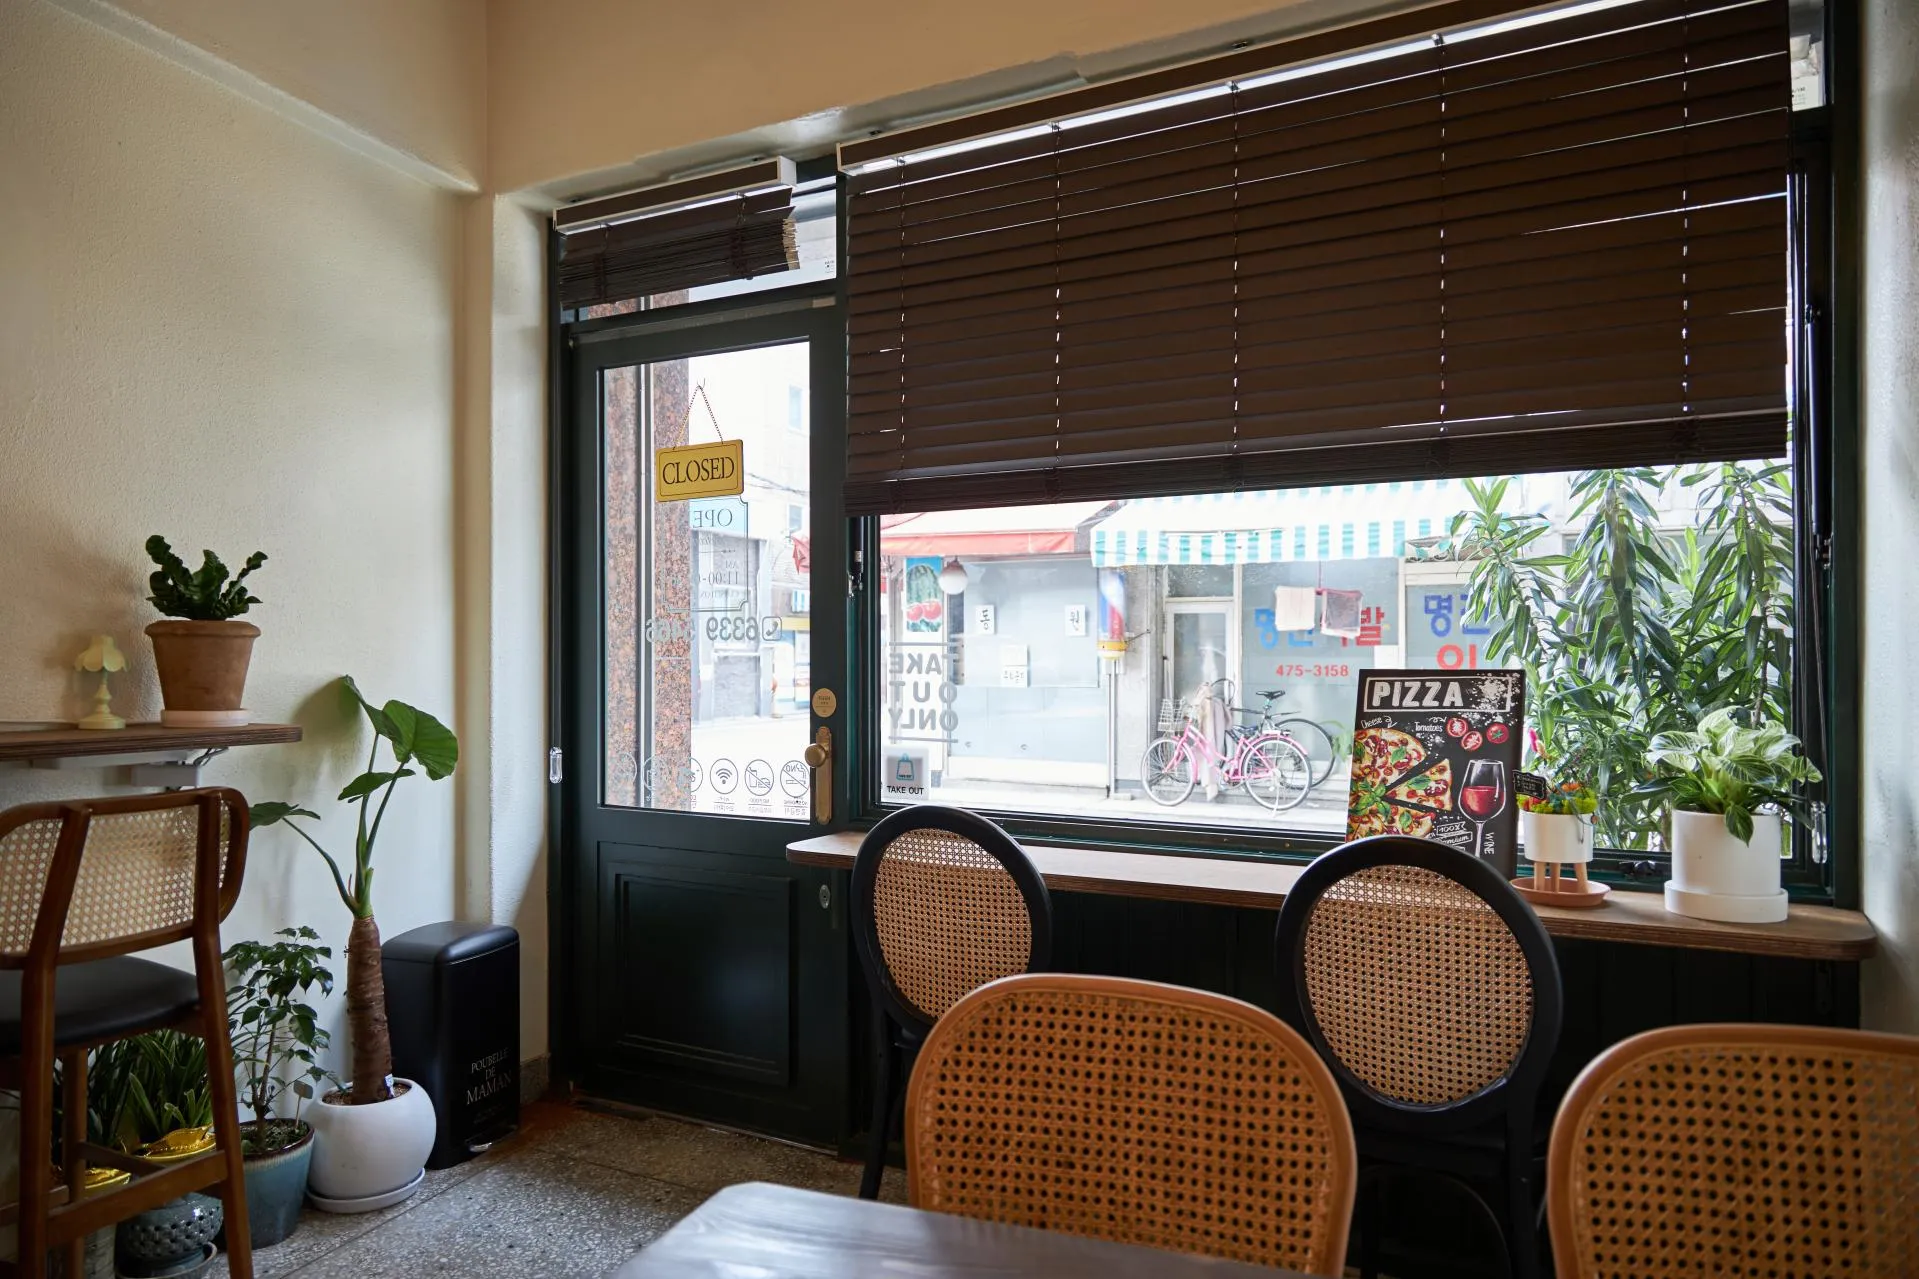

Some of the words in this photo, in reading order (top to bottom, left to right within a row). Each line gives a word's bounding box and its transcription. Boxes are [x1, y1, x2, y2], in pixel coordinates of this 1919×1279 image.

[662, 456, 735, 485] CLOSED
[1275, 664, 1349, 677] 475-3158
[1372, 681, 1464, 707] PIZZA
[1414, 721, 1444, 732] Tomatoes
[887, 785, 906, 794] TAKE
[908, 786, 924, 795] OUT
[1484, 832, 1495, 855] WINE
[485, 1066, 496, 1080] DE
